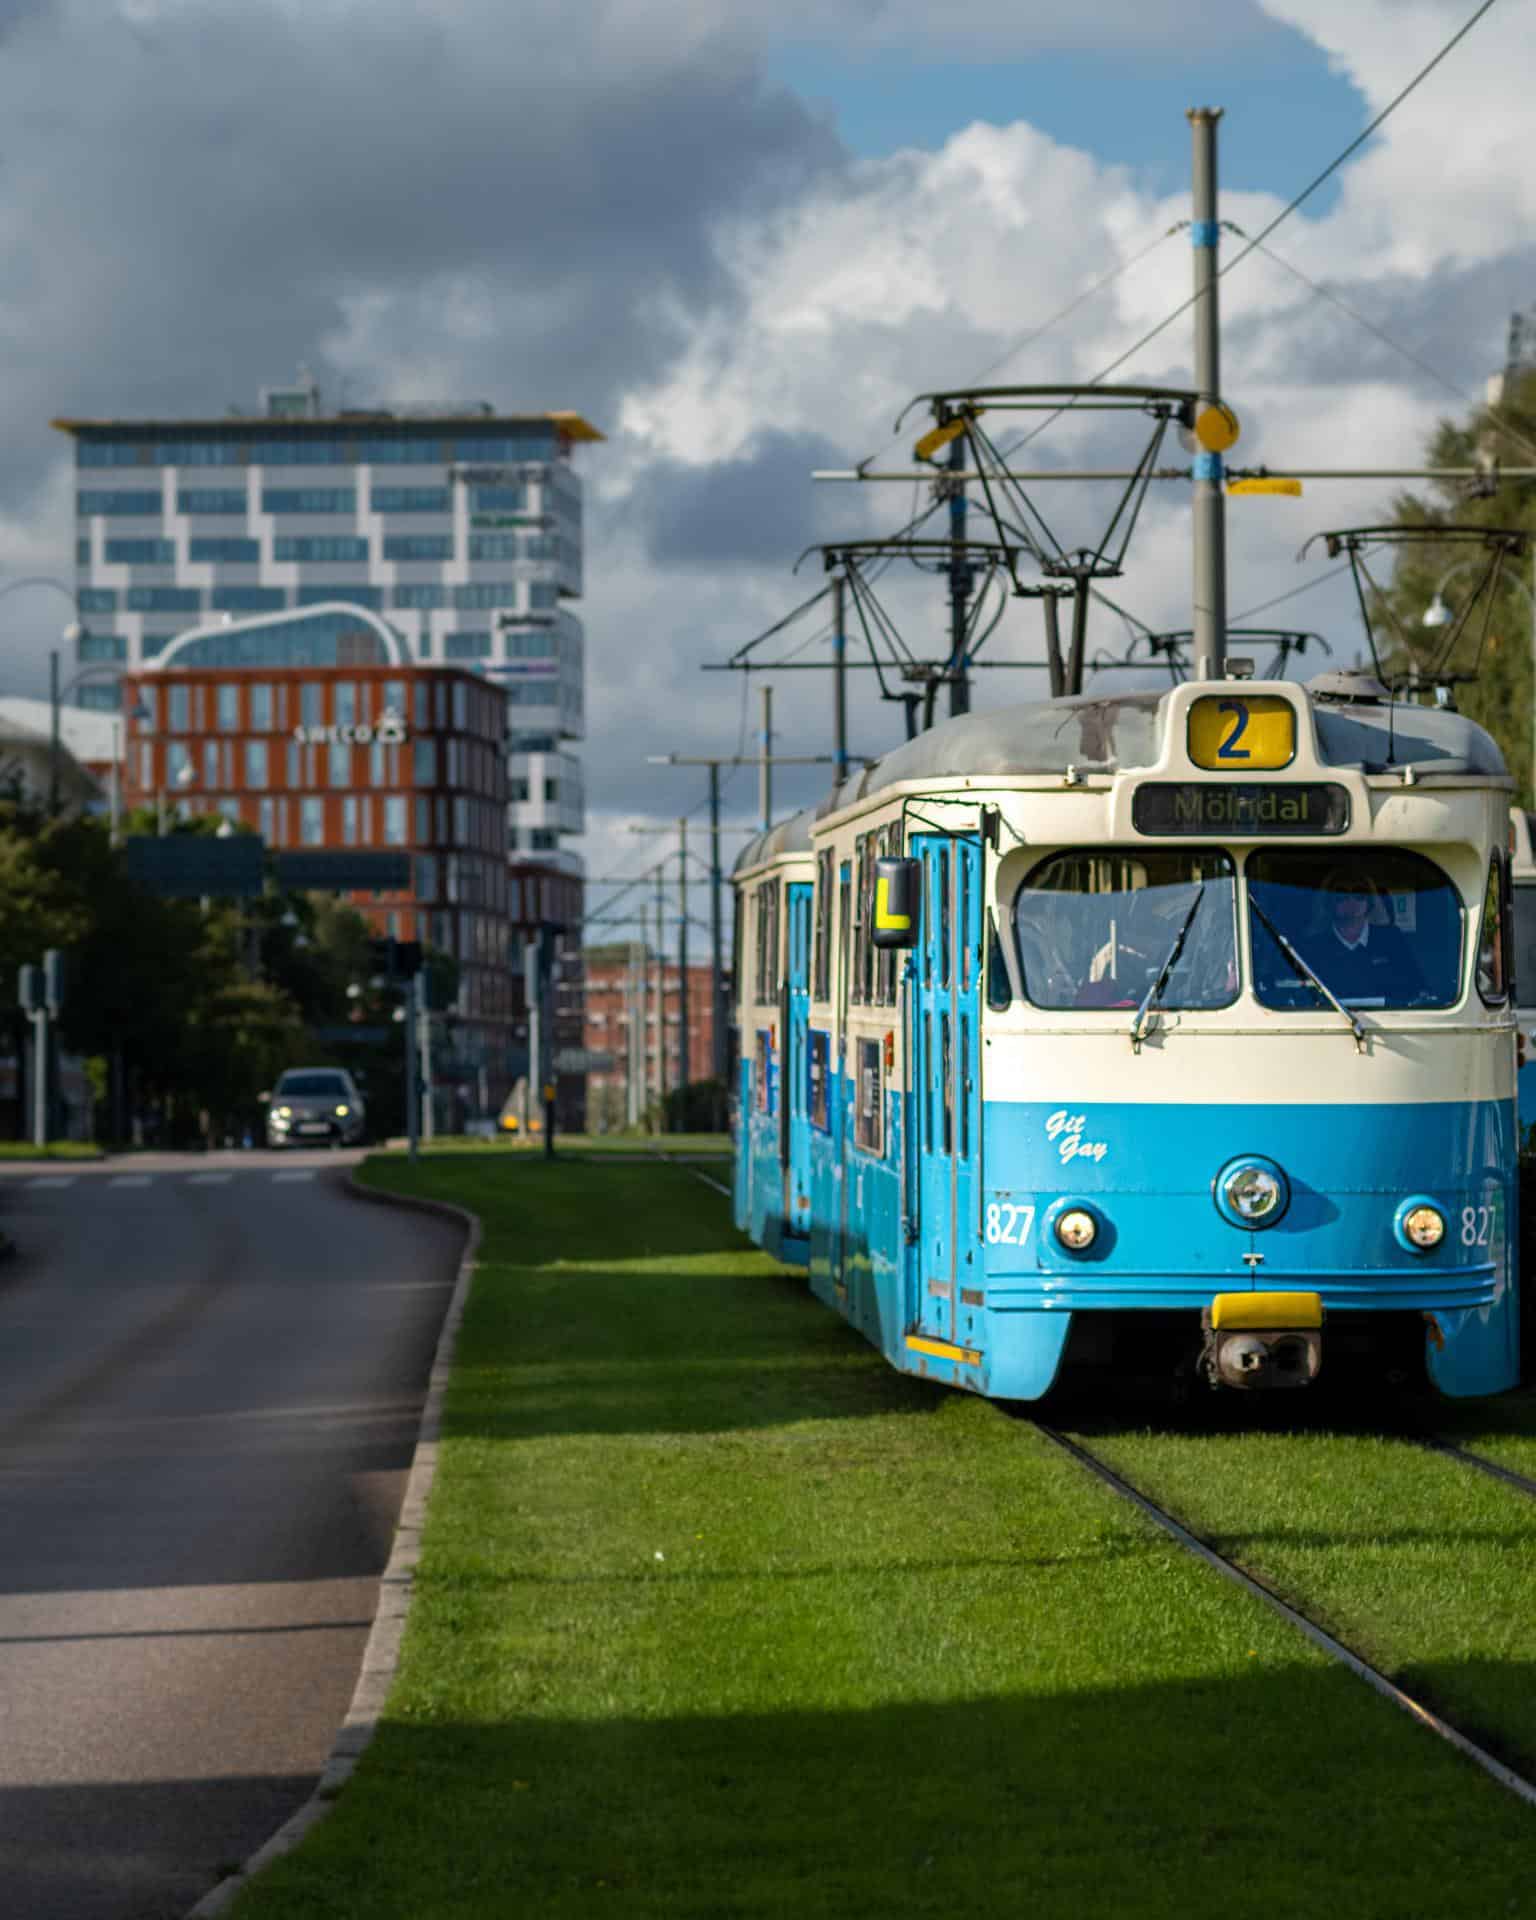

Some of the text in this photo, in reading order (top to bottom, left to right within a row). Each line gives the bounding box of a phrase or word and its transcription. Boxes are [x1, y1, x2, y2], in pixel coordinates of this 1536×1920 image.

[1217, 702, 1250, 758] 2
[1174, 792, 1309, 821] Mölndal
[1045, 1110, 1085, 1141] Git
[1059, 1134, 1108, 1165] Gay
[986, 1203, 1035, 1246] 827
